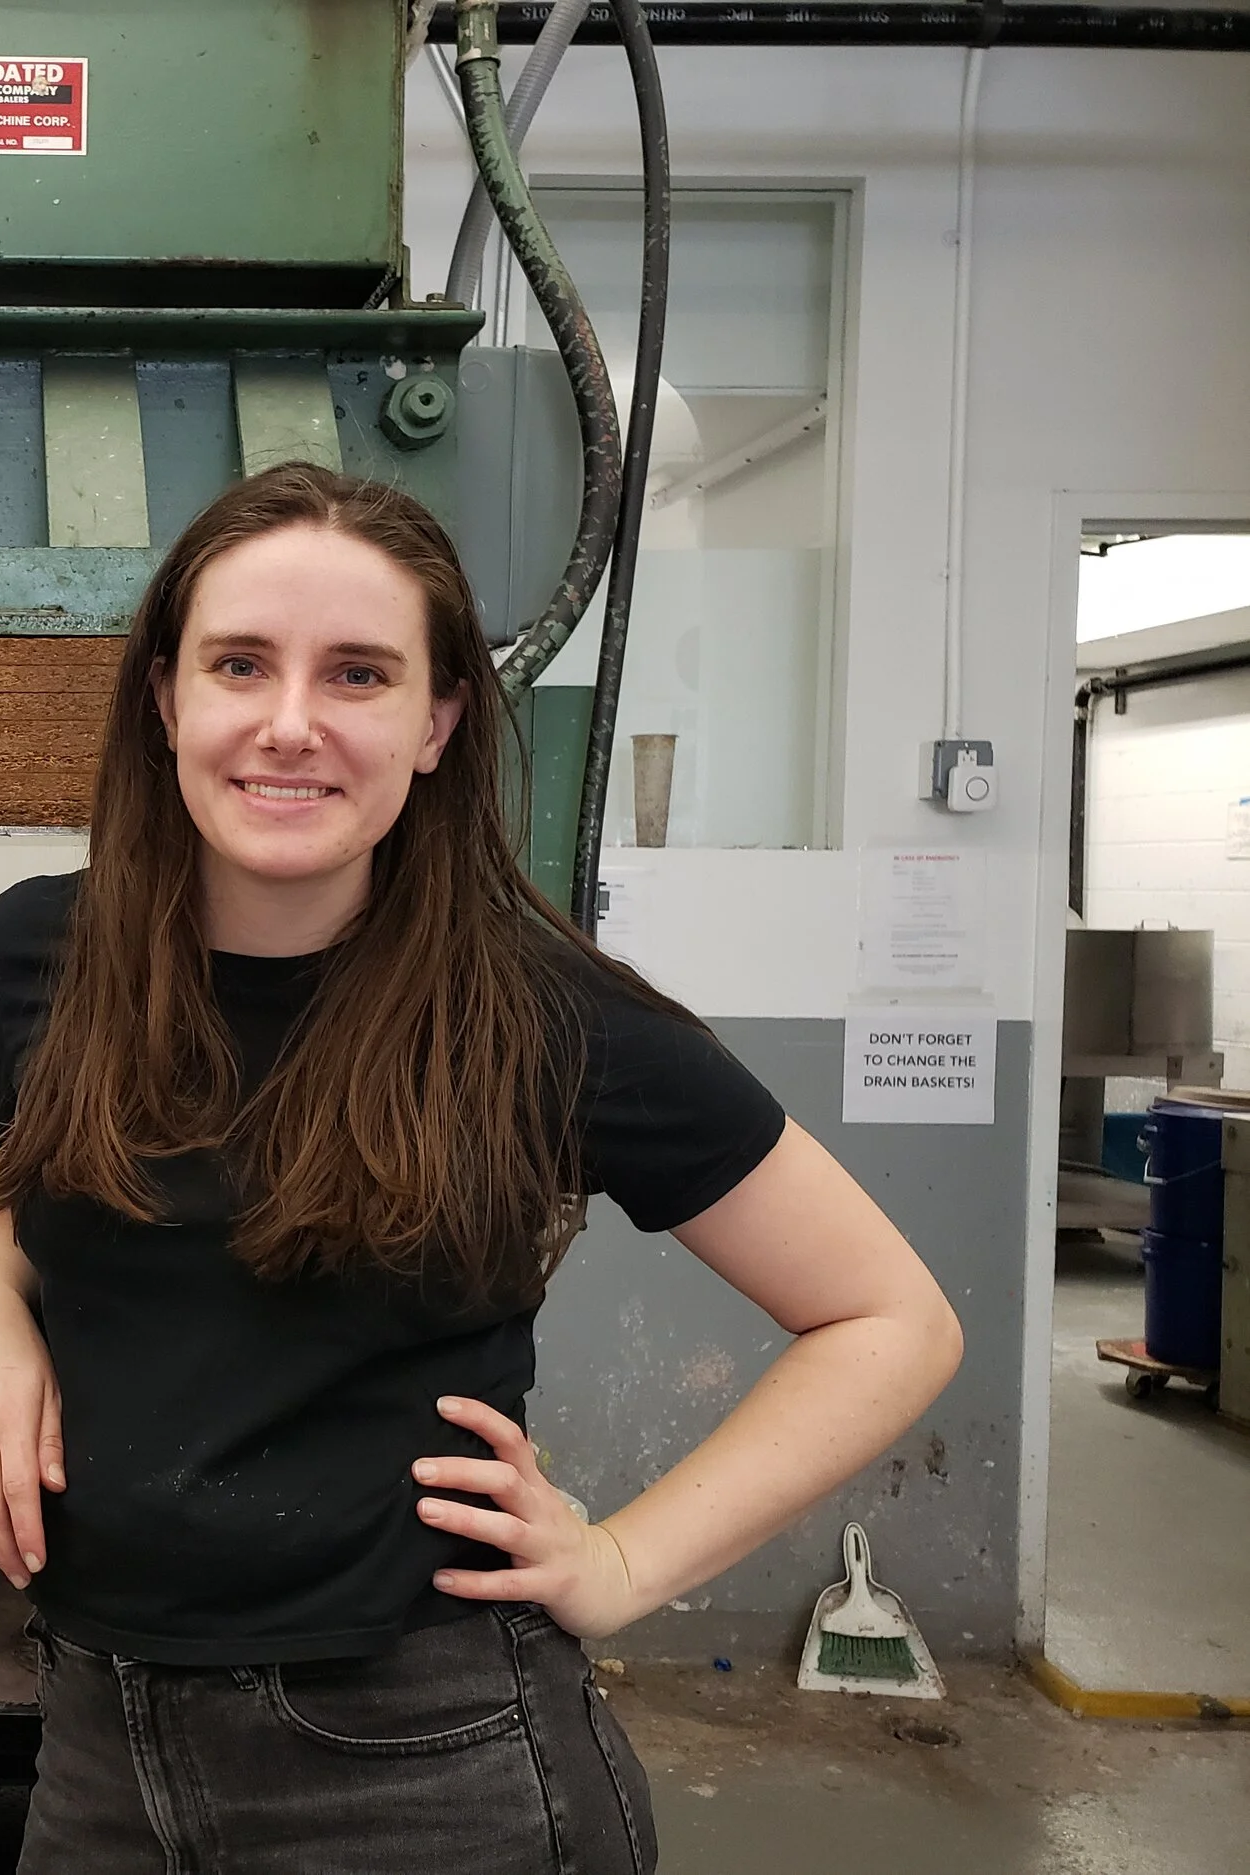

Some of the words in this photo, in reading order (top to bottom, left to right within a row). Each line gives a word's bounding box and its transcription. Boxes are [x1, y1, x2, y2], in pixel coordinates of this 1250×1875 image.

[646, 8, 686, 22] CHIN
[33, 116, 71, 127] CORP.
[869, 1033, 914, 1045] DON'T
[918, 1033, 972, 1046] FORGET
[863, 1054, 883, 1066] TO
[887, 1054, 946, 1067] CHANGE
[950, 1055, 976, 1067] THE
[864, 1076, 907, 1087] DRAIN
[911, 1076, 975, 1088] BASKETS!
